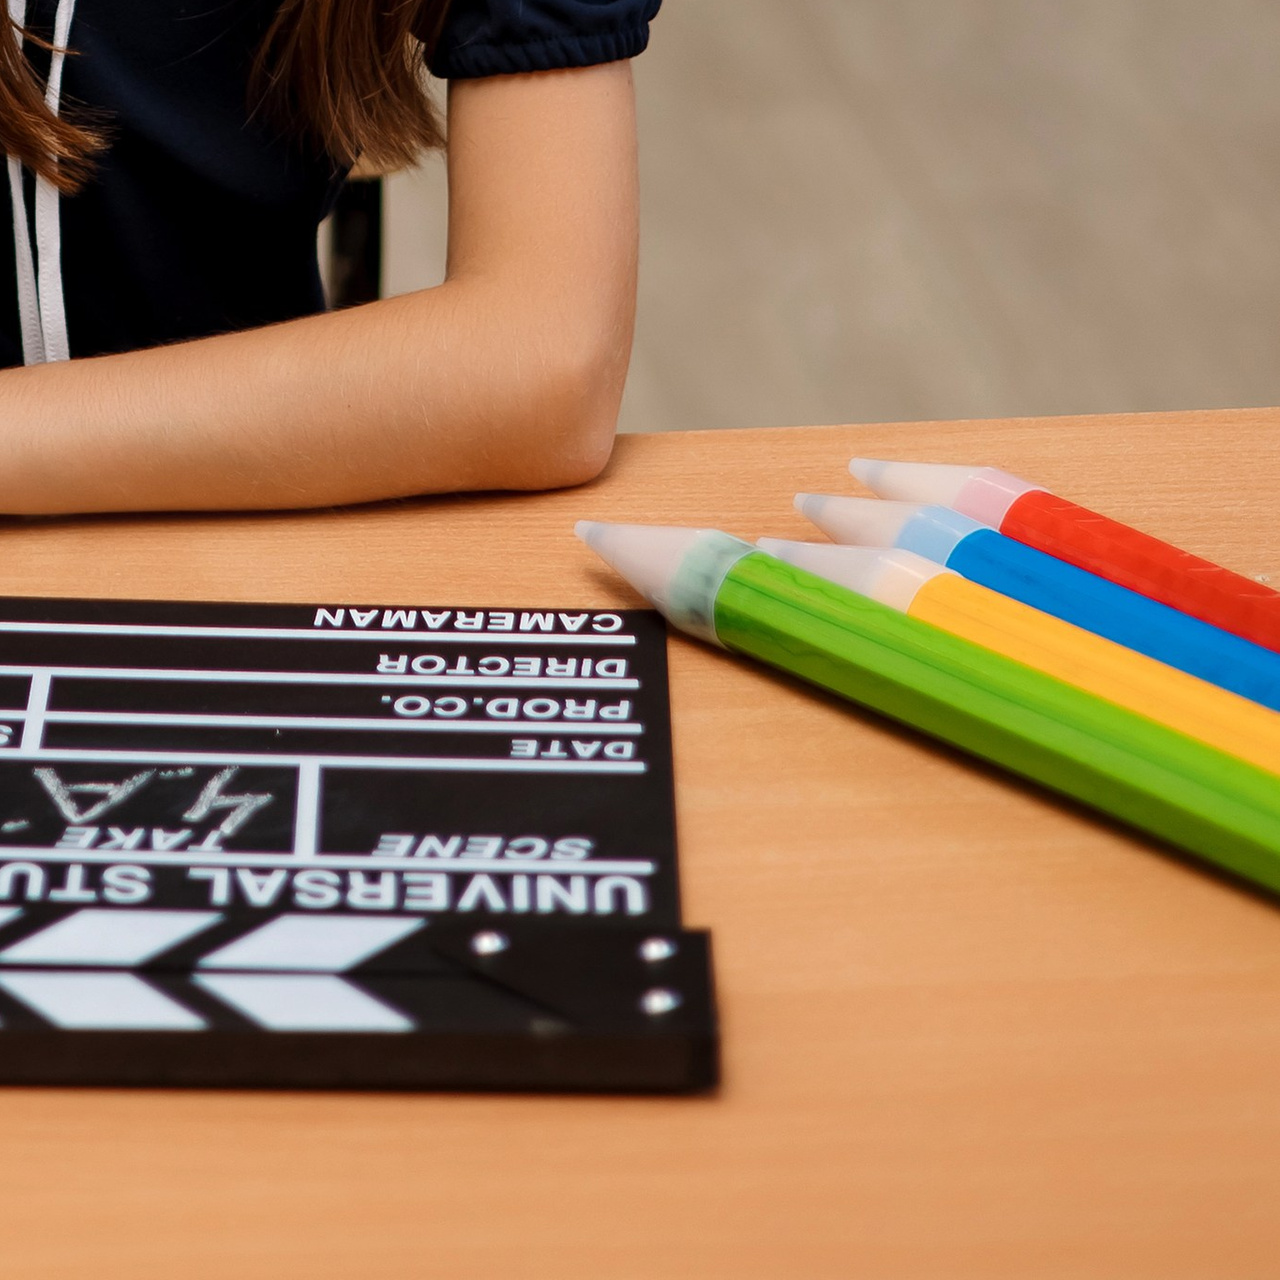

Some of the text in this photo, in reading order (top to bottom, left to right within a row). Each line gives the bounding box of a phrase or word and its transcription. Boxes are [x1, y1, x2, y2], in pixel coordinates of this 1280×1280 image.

[313, 608, 623, 632] CAMERAMAN
[376, 653, 627, 678] DIRECTOR
[381, 694, 631, 720] PROD.CO.
[510, 738, 634, 759] DATE
[54, 826, 222, 852] TAKE
[371, 835, 594, 861] SCENE
[187, 867, 648, 914] UNIVERSAL
